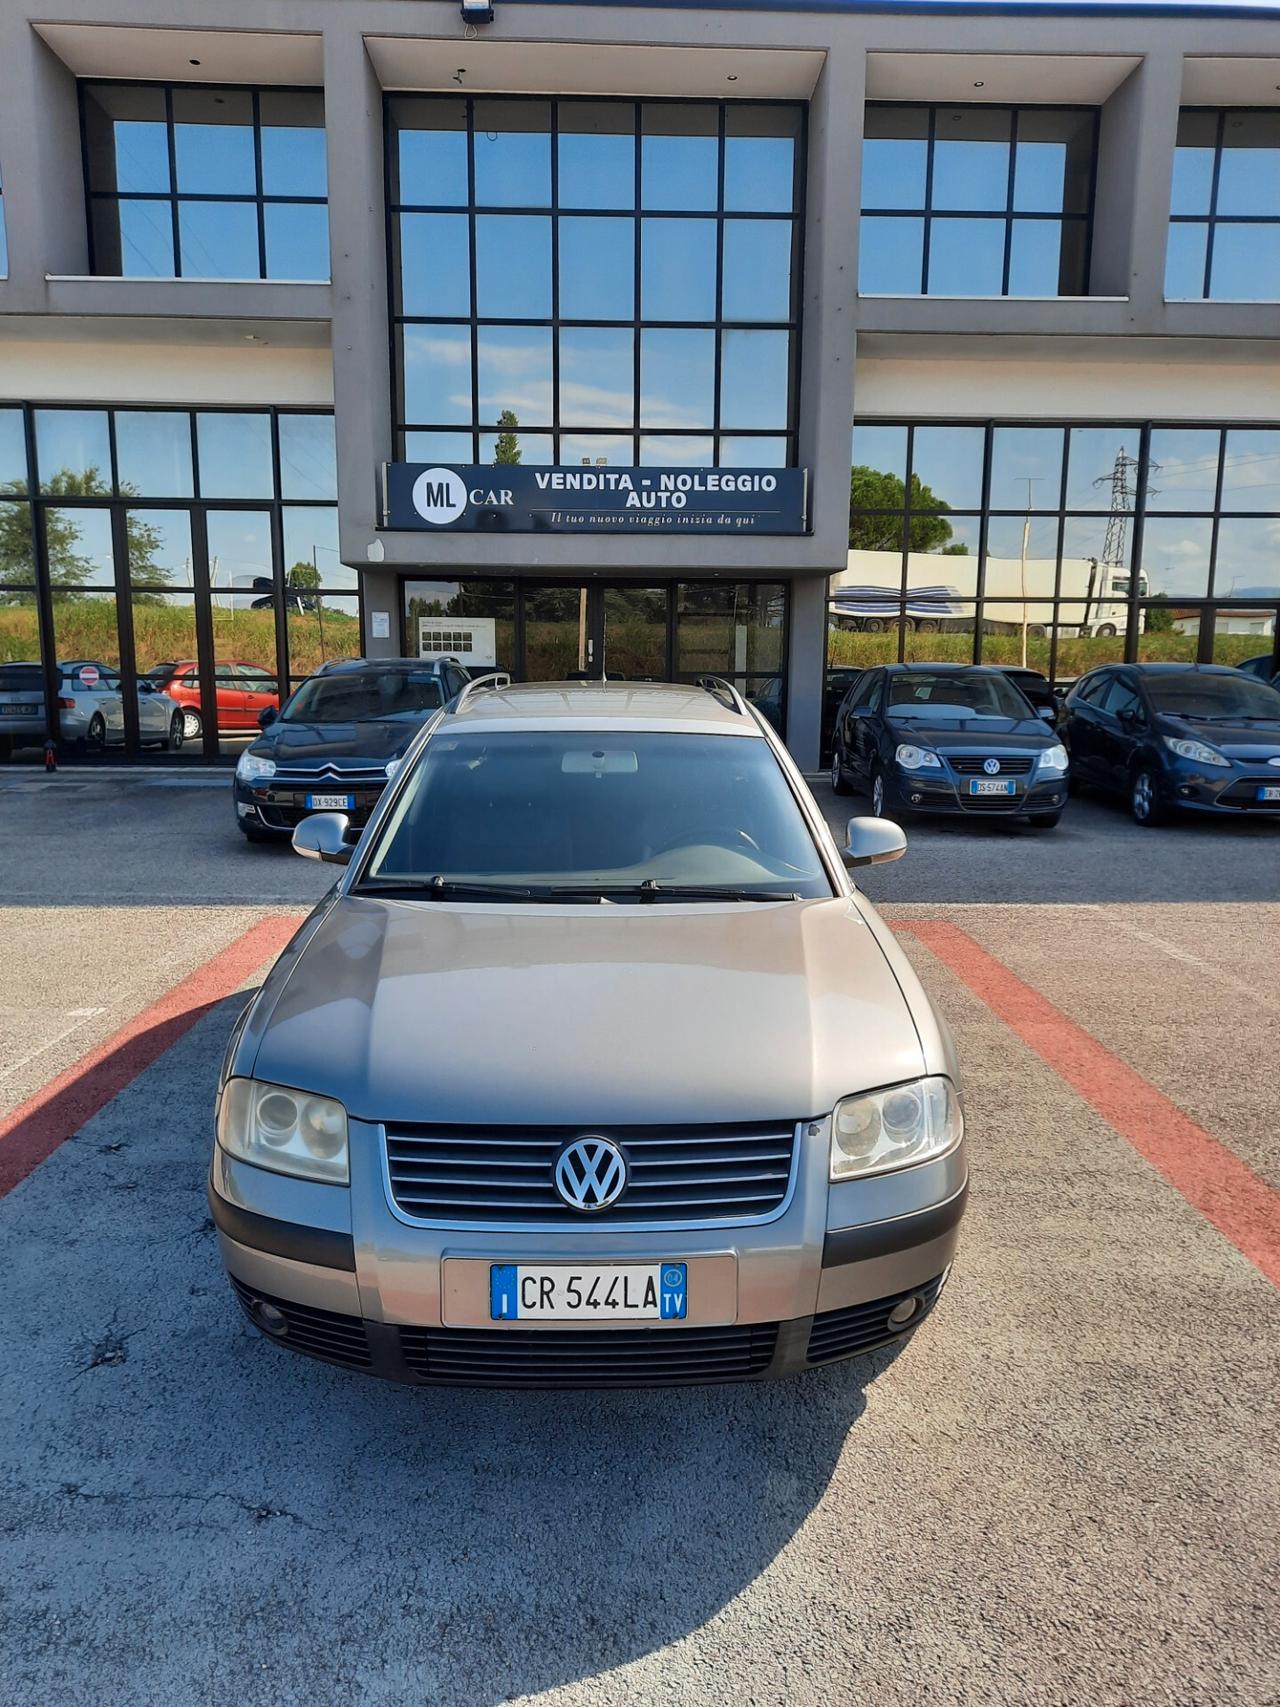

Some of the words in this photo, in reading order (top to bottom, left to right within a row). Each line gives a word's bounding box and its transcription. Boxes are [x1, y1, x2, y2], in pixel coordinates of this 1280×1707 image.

[534, 472, 634, 491] VENDITA
[660, 474, 777, 492] NOLEGGIO
[426, 481, 456, 508] ML
[469, 488, 514, 506] CAR
[625, 491, 687, 508] AUTO
[551, 512, 562, 523] Il
[566, 513, 585, 524] tuo
[589, 514, 625, 524] nuovo
[629, 513, 672, 527] viaggio
[677, 514, 713, 525] inizia
[717, 514, 731, 525] da
[521, 1275, 555, 1310] CR
[565, 1275, 658, 1310] 544LA
[663, 1293, 683, 1313] TV
